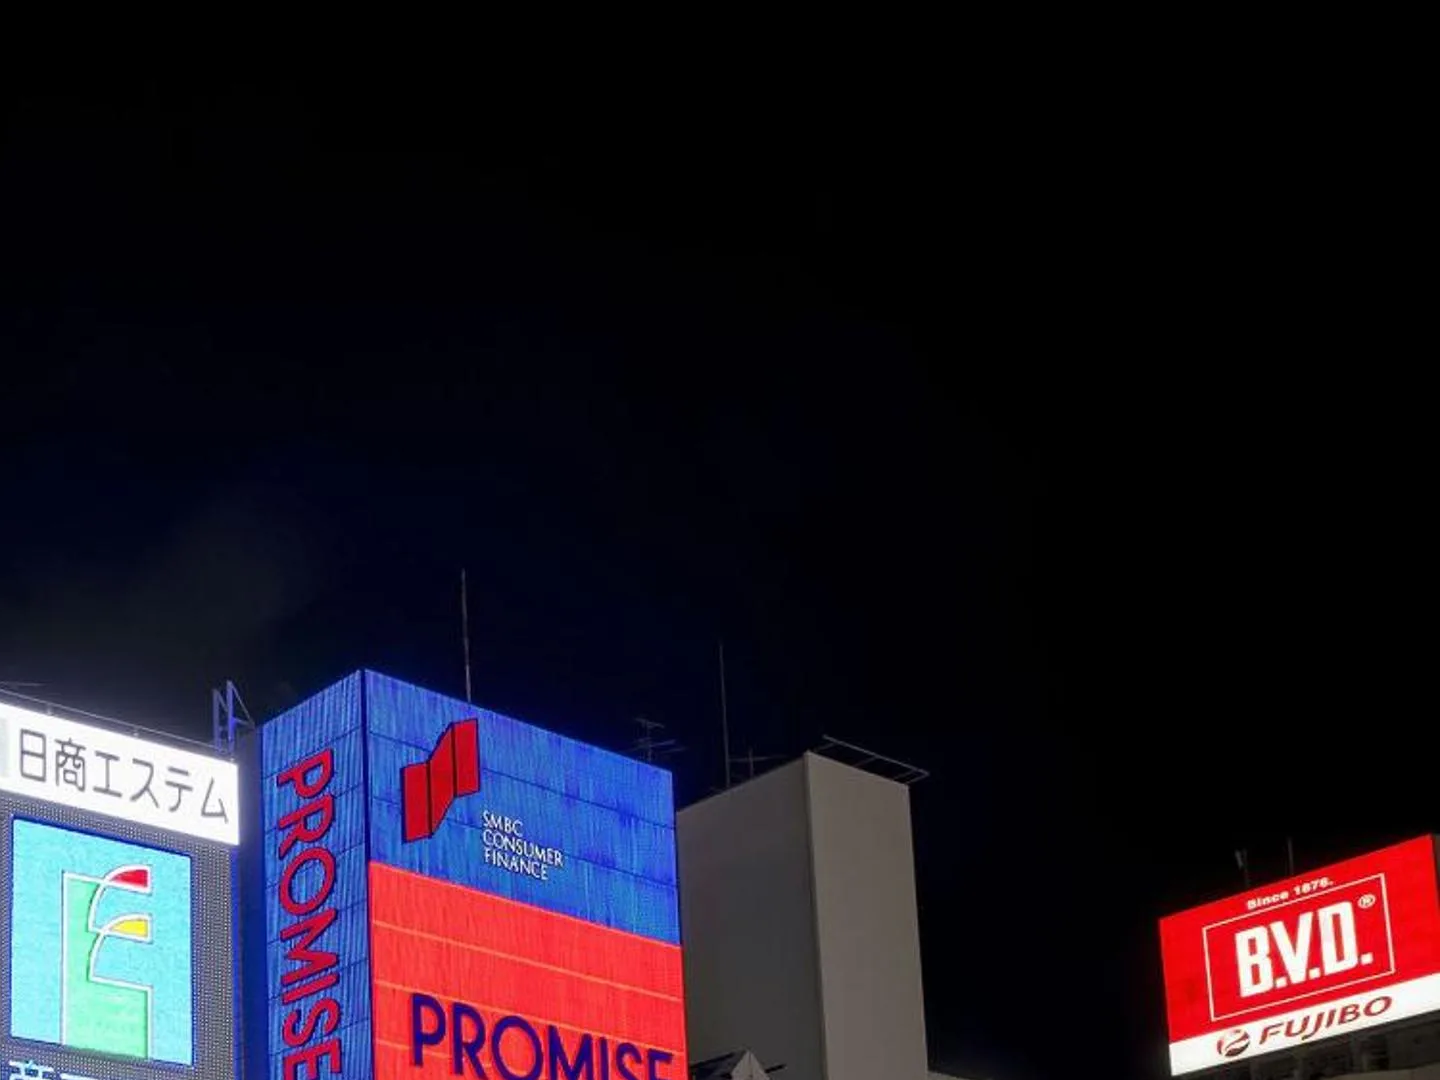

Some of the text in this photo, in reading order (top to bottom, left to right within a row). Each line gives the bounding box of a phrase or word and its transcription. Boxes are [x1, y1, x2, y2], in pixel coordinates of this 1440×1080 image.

[19, 727, 230, 824] 日商エステム
[482, 810, 524, 835] SMBC
[482, 828, 564, 867] CONSUMER
[484, 847, 549, 881] FINANCE
[1247, 891, 1289, 910] Since
[1234, 901, 1374, 998] B.V.D.
[1259, 995, 1393, 1045] FUJIBO
